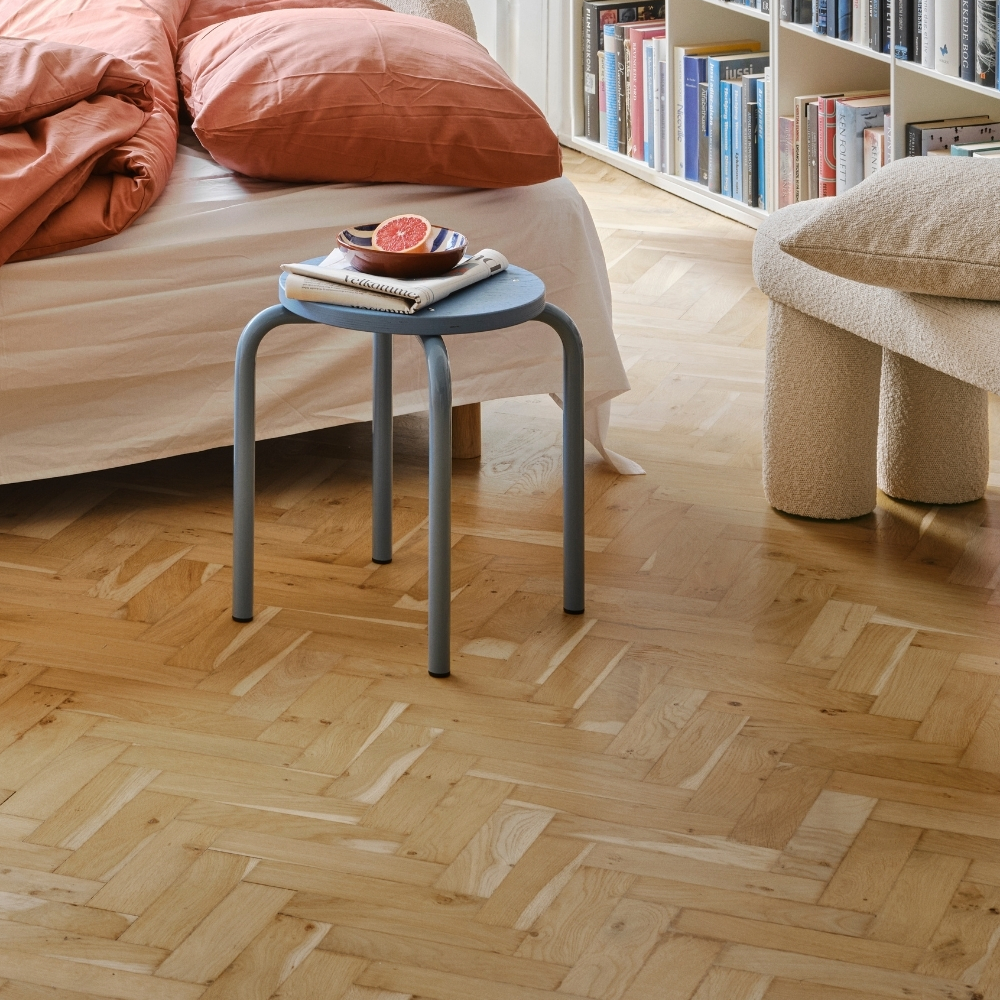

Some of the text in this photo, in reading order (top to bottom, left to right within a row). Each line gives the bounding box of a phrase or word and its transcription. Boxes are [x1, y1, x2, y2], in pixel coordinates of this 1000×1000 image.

[725, 63, 754, 80] jussi
[676, 103, 684, 143] Niceville
[839, 113, 847, 185] KEN FOLLETT
